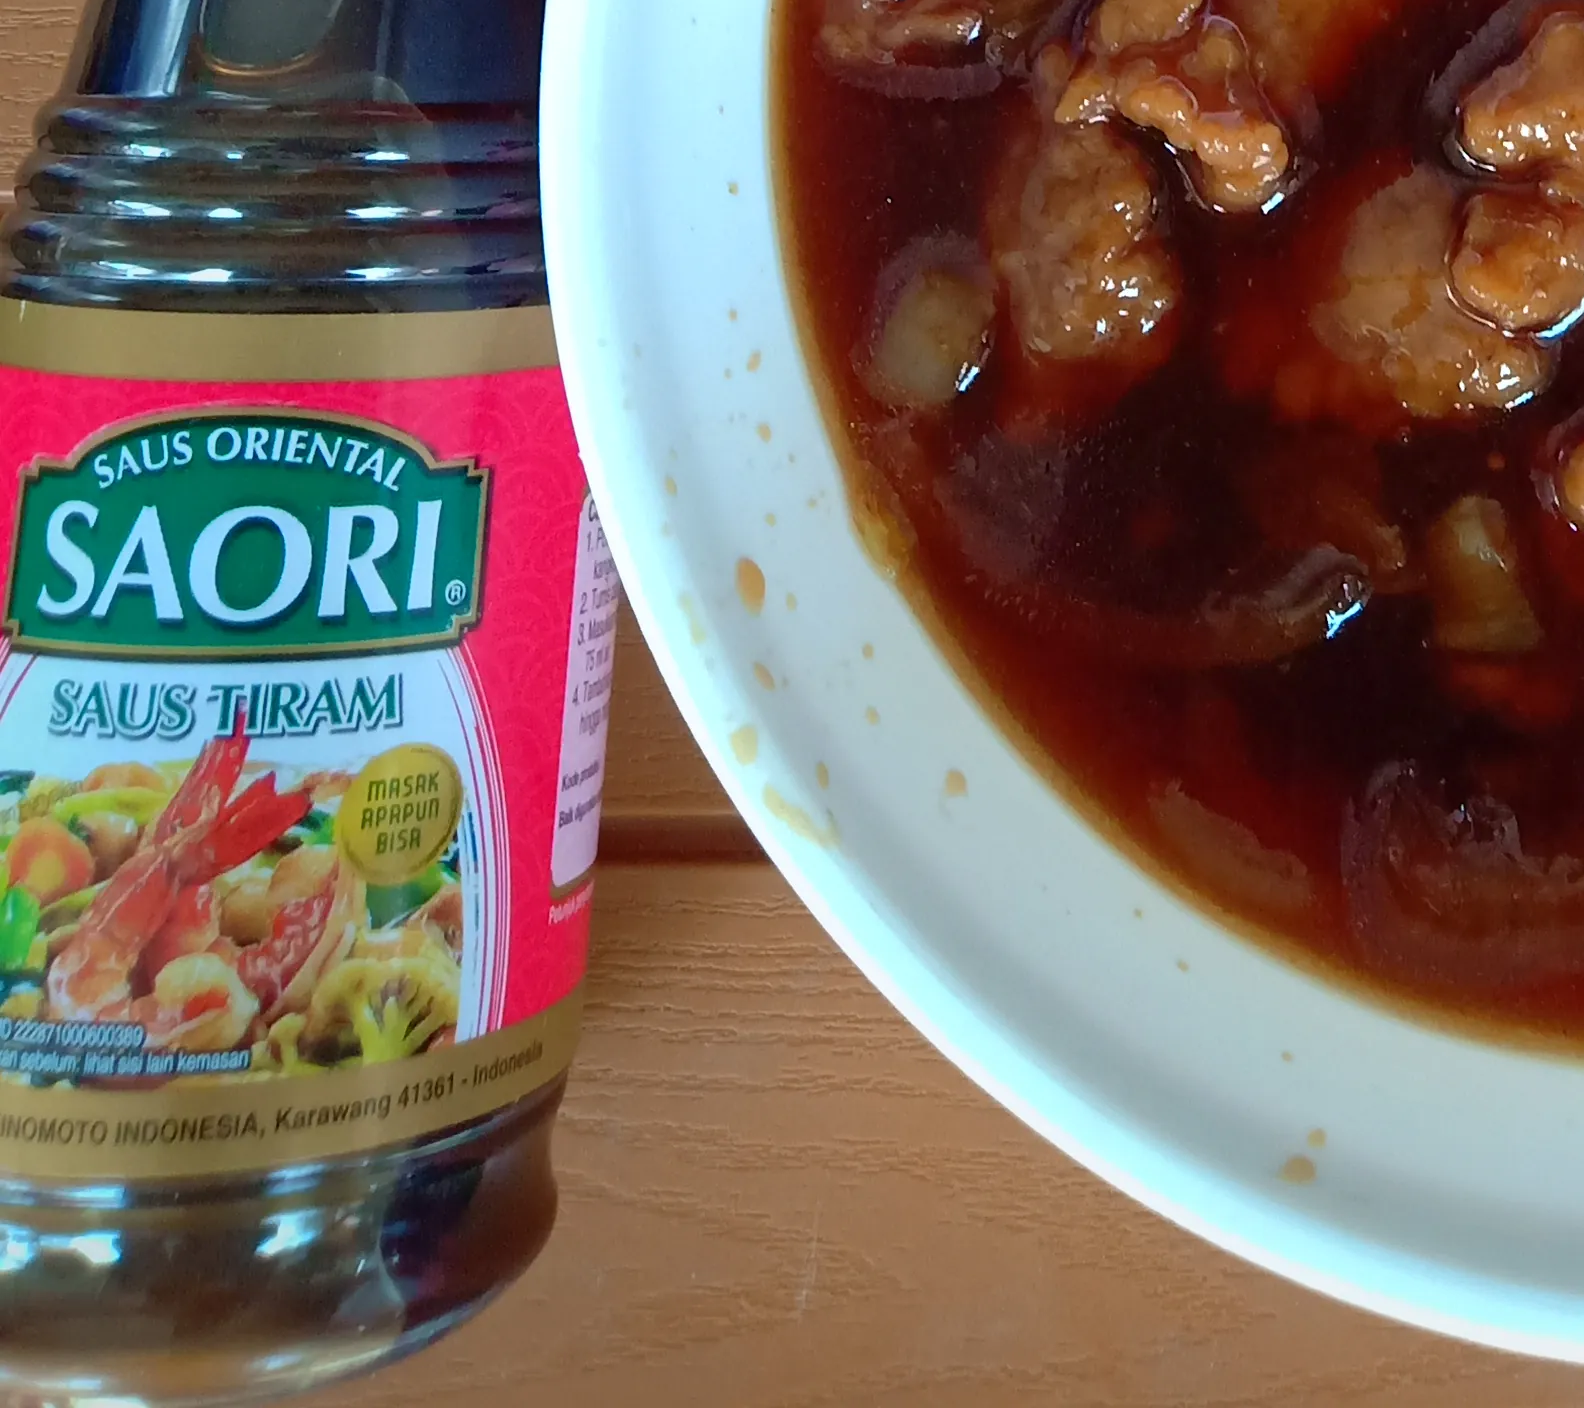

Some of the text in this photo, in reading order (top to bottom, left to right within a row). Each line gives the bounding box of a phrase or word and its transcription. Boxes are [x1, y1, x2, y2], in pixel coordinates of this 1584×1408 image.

[94, 427, 406, 492] SAUS ORIENTAL
[36, 498, 443, 624] SAORI
[48, 672, 403, 740] SAUS TIRAM
[367, 771, 439, 802] MASAK
[361, 797, 439, 830] APAPUN
[375, 826, 421, 855] BISA
[83, 1051, 115, 1076] lihat
[117, 1050, 144, 1075] sisi
[146, 1050, 174, 1073] lain
[177, 1048, 250, 1073] kemasan
[0, 1113, 108, 1145] INOMOTO
[113, 1111, 265, 1147] INDONESIA,
[275, 1094, 391, 1132] Karawang
[397, 1073, 455, 1108] 41361
[472, 1038, 544, 1088] Indonesia
